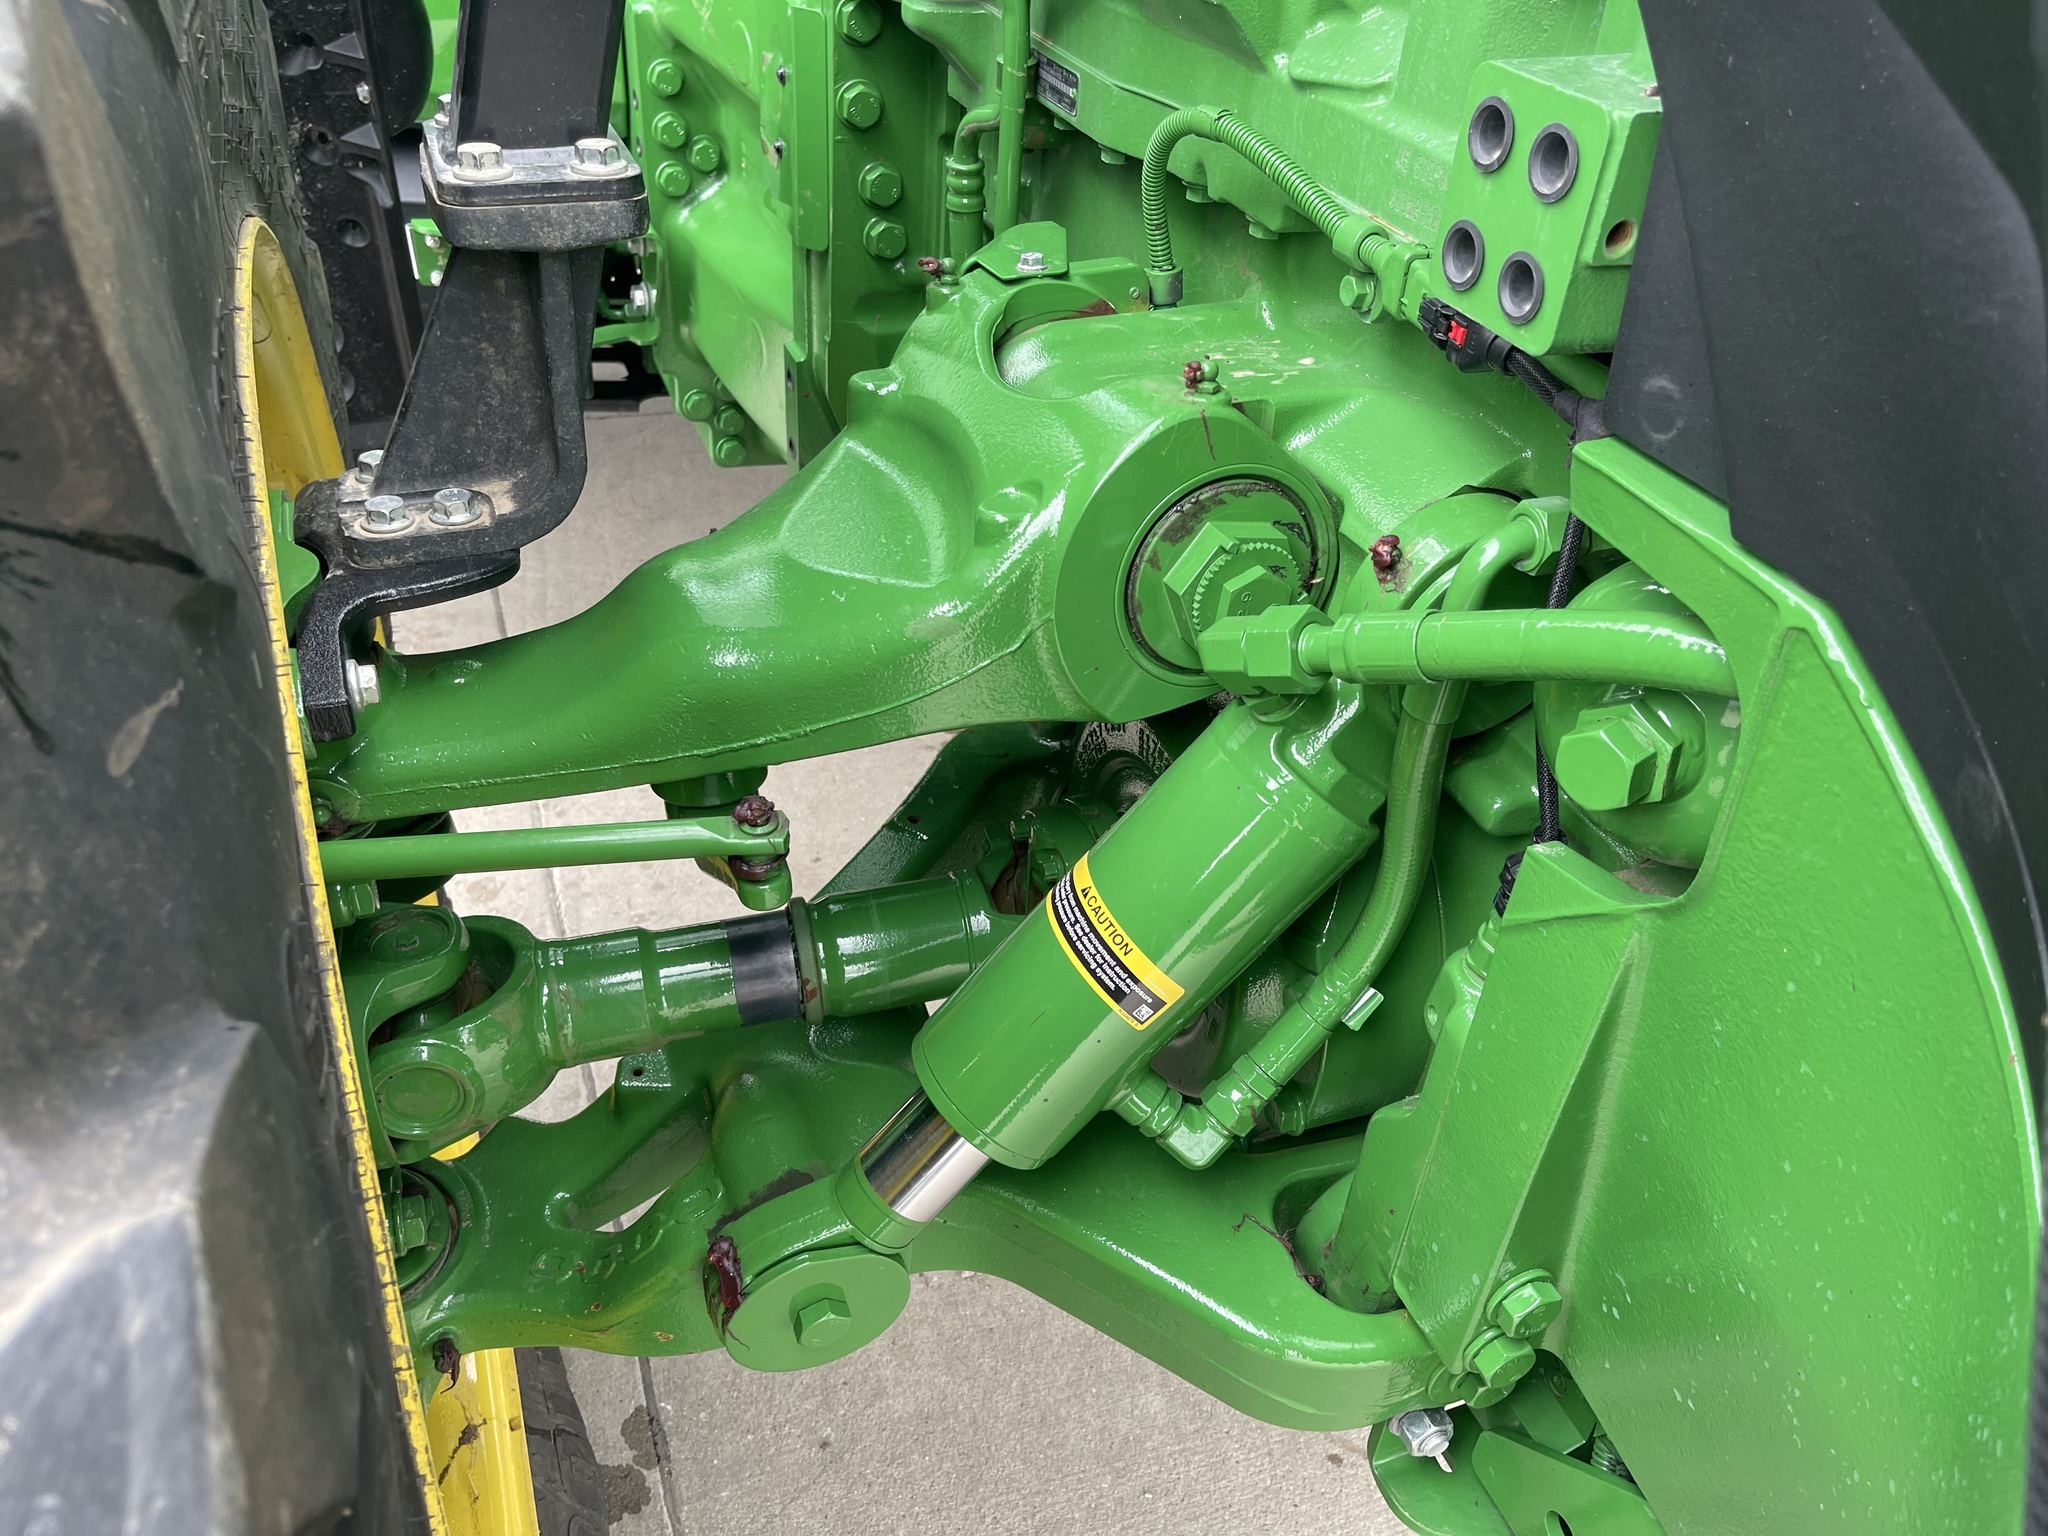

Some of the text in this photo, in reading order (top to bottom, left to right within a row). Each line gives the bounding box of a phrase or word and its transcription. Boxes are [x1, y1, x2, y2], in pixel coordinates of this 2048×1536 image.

[1064, 920, 1077, 941] before
[1075, 940, 1097, 969] servicing
[1095, 967, 1115, 991] system.
[1068, 892, 1076, 908] from
[1073, 906, 1090, 933] machine
[1087, 932, 1117, 967] movement
[1114, 966, 1128, 980] and
[1125, 978, 1153, 1003] exposure
[1074, 923, 1083, 937] See
[1081, 935, 1097, 955] dealer
[1094, 953, 1104, 964] for
[1087, 895, 1134, 956] CAUTION
